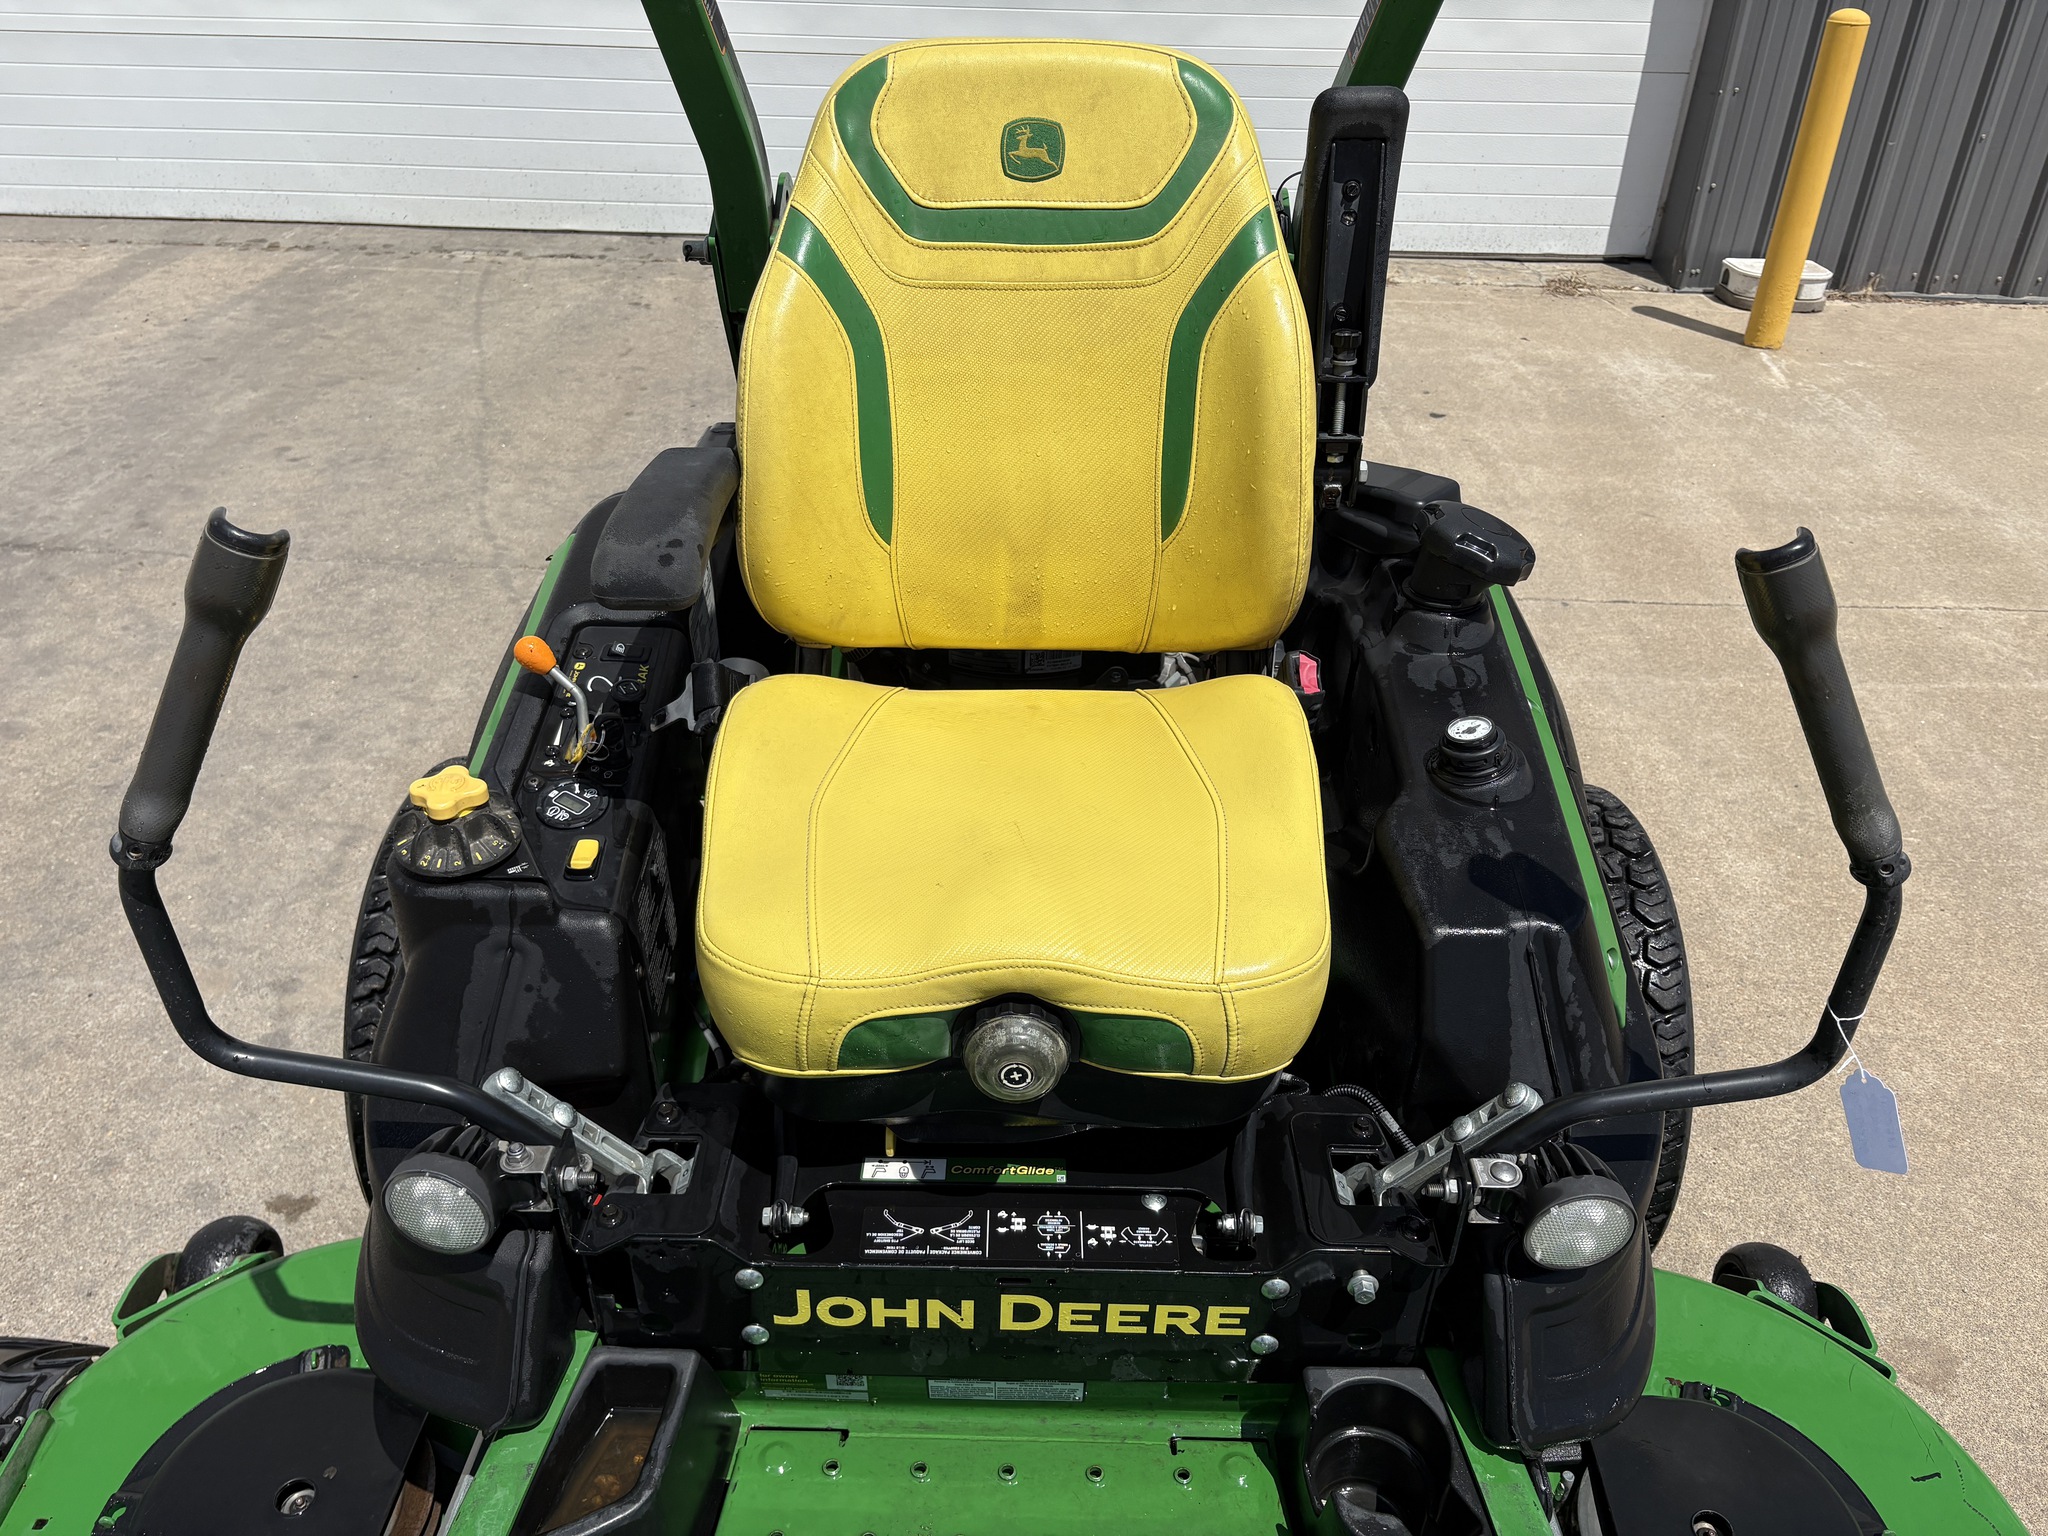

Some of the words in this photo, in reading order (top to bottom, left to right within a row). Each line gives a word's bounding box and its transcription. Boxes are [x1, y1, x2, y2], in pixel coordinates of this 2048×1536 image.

[1027, 1027, 1040, 1037] 235
[773, 1289, 975, 1330] JOHN
[999, 1293, 1251, 1336] DEERE
